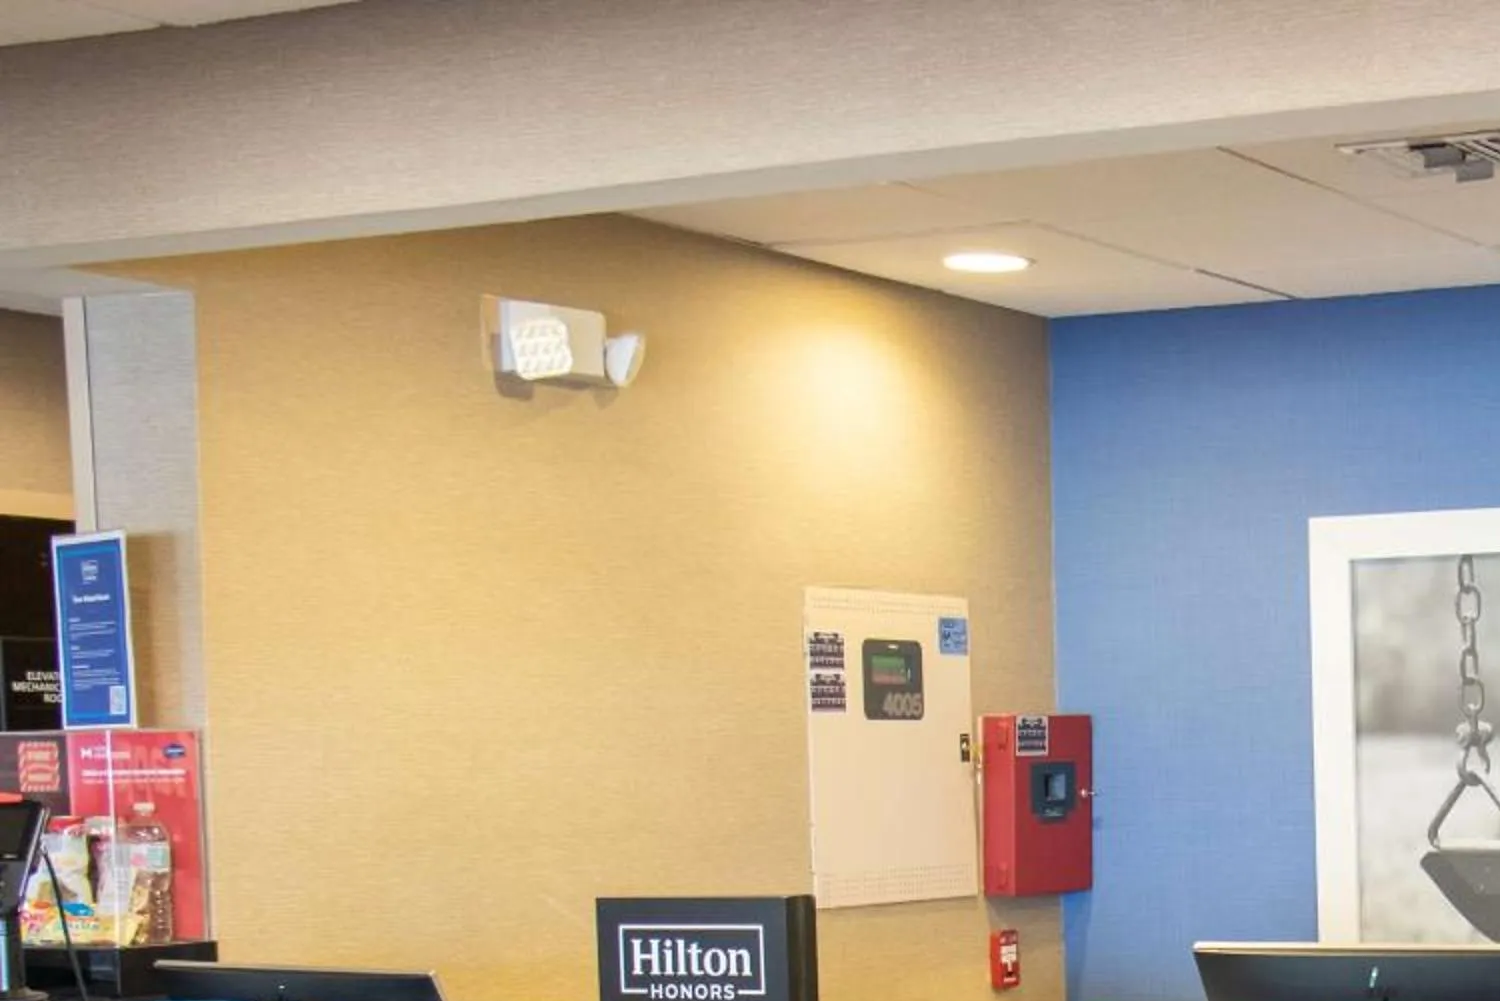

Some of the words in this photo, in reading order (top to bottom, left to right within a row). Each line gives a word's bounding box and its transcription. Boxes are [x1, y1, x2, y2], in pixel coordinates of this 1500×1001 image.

[883, 692, 923, 717] 4005
[630, 937, 753, 977] Hilton
[650, 983, 736, 1001] HONORS
